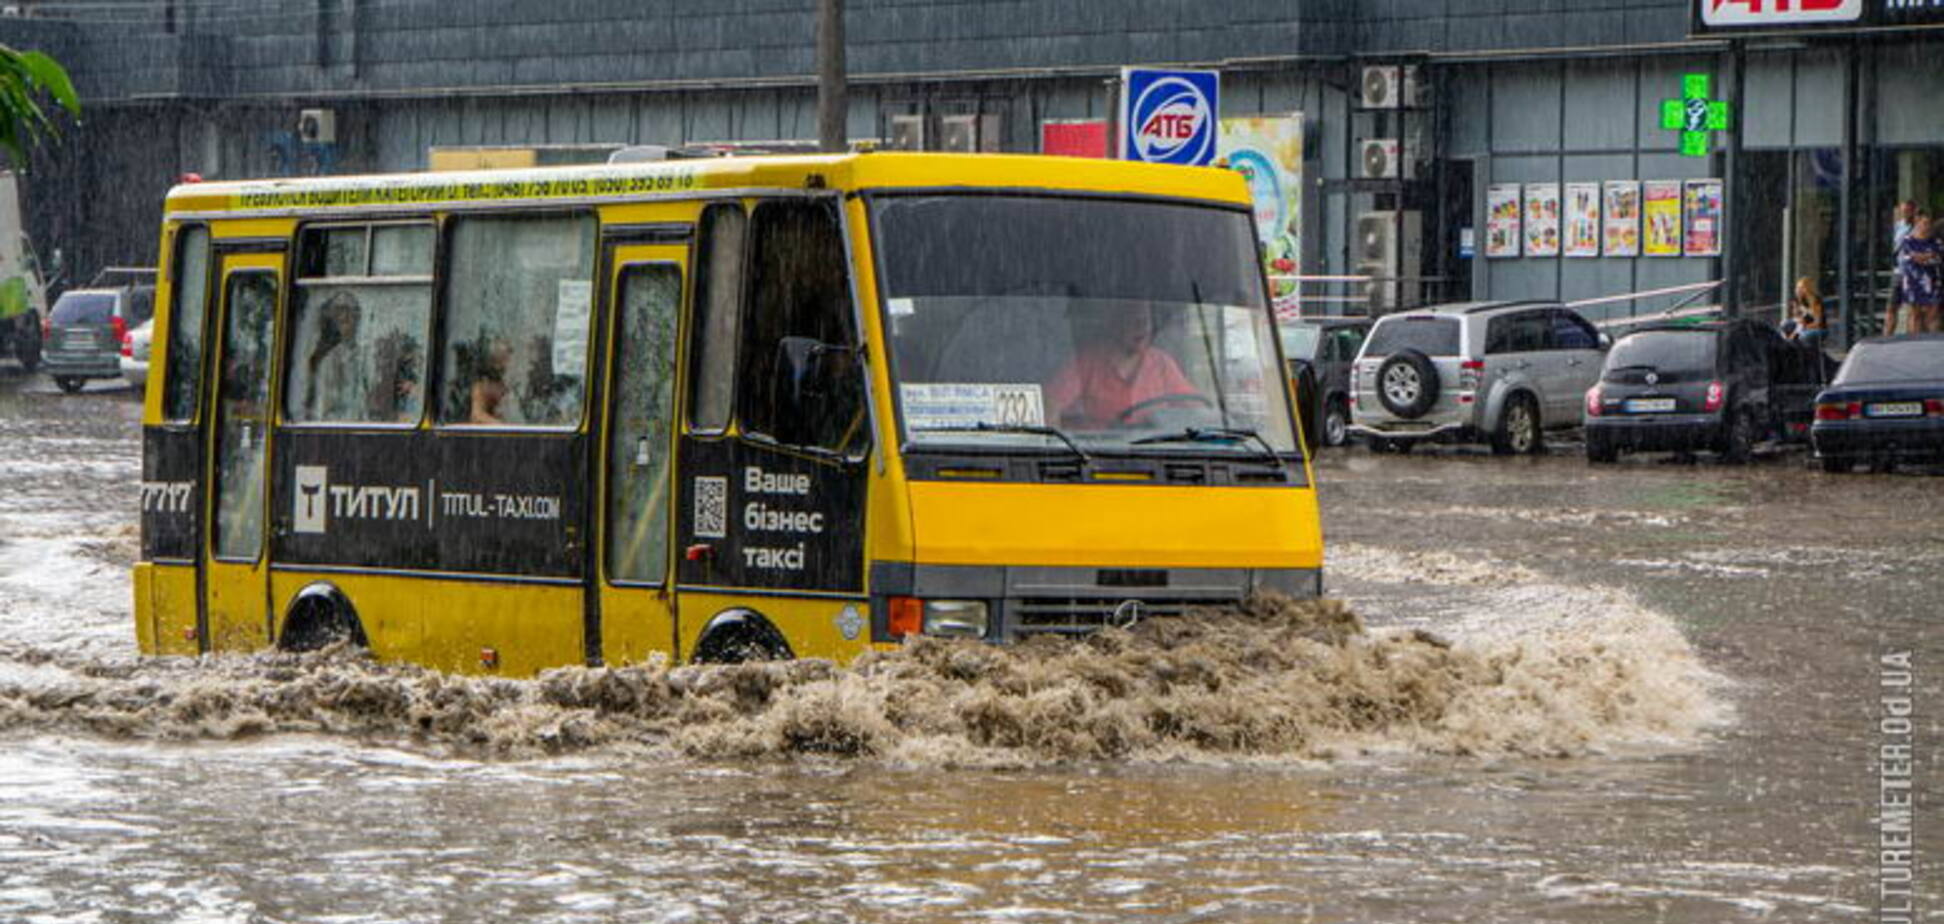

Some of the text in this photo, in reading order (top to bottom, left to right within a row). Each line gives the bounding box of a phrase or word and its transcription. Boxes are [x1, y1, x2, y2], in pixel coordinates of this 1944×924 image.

[1143, 114, 1194, 139] АТБ
[744, 466, 811, 494] Ваше
[329, 485, 419, 520] ТИТУЛ
[744, 502, 824, 532] бізнес
[742, 542, 805, 570] таксі
